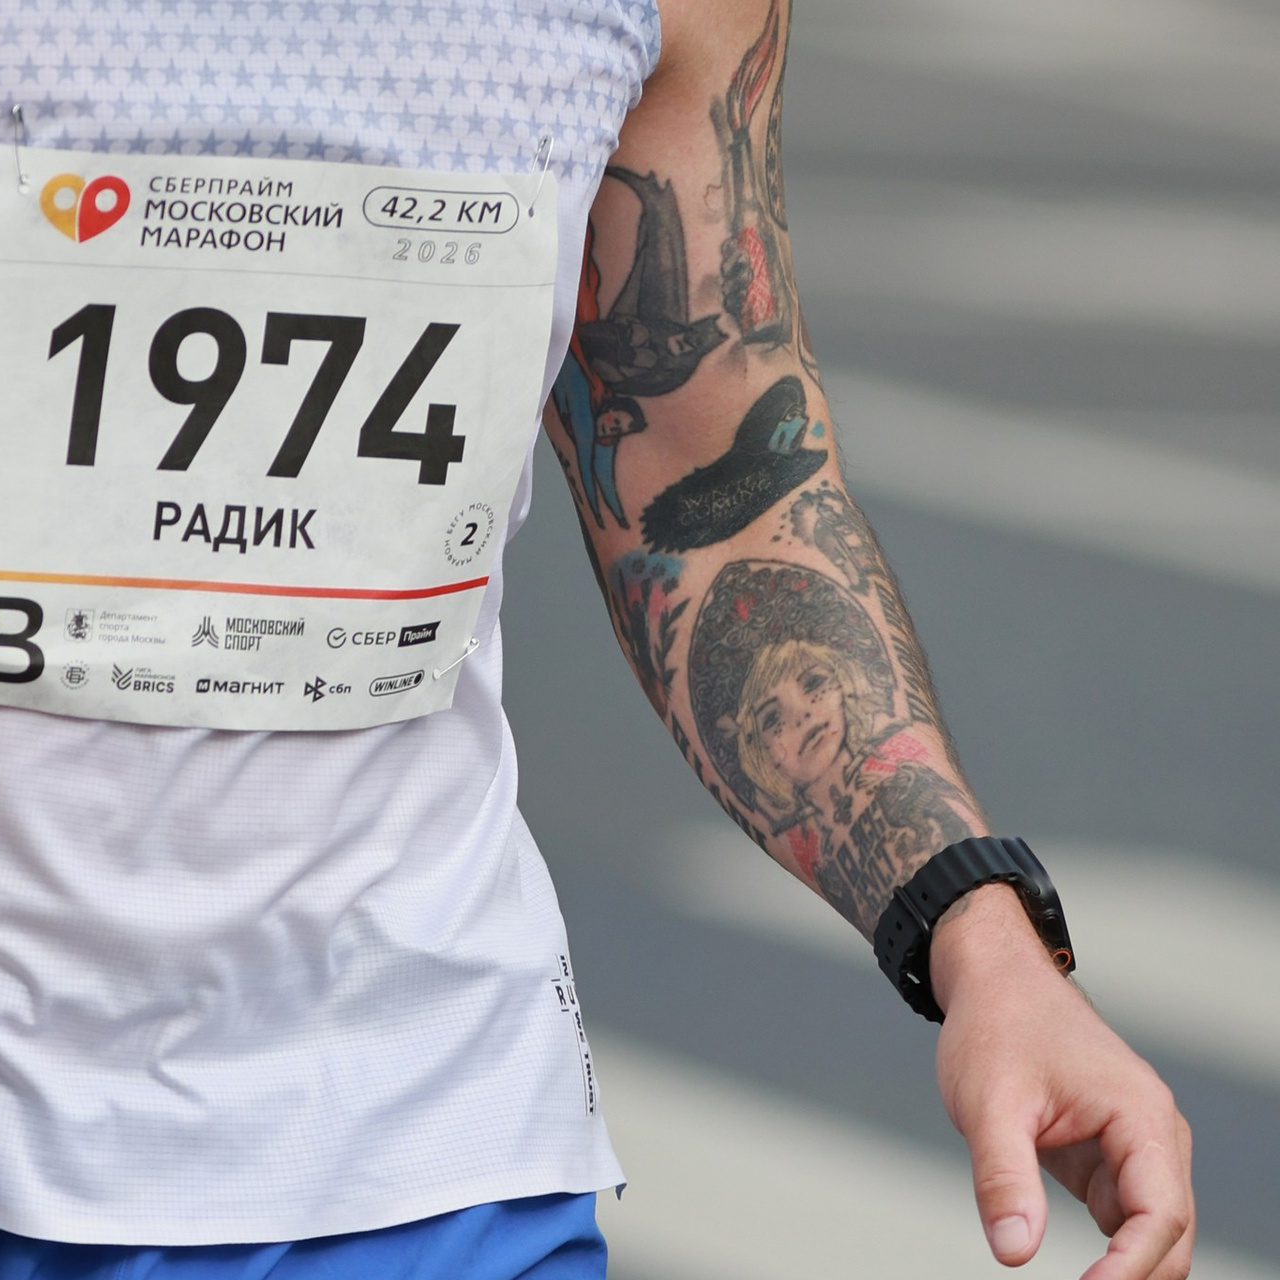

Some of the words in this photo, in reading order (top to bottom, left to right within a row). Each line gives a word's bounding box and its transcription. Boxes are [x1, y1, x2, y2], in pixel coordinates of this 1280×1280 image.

[148, 175, 294, 198] СБЕРПРАЙМ
[144, 198, 344, 229] МОСКОВСКИЙ
[380, 195, 447, 224] 42,2
[140, 226, 287, 253] МАРАФОН
[391, 237, 484, 266] 2026
[47, 303, 466, 486] 1974
[152, 500, 318, 555] РАДИК
[460, 521, 478, 547] 2
[99, 610, 159, 622] Департамент
[225, 616, 306, 637] МОСКОВСКИЙ
[99, 622, 130, 632] спорта
[351, 631, 397, 646] СБЕР
[402, 627, 433, 643] Прайм
[98, 633, 129, 643] города
[131, 634, 166, 645] Москвы
[224, 634, 263, 652] СПОРТ
[132, 680, 175, 695] BRICS
[328, 683, 352, 695] сбп
[373, 675, 416, 693] WINLINE
